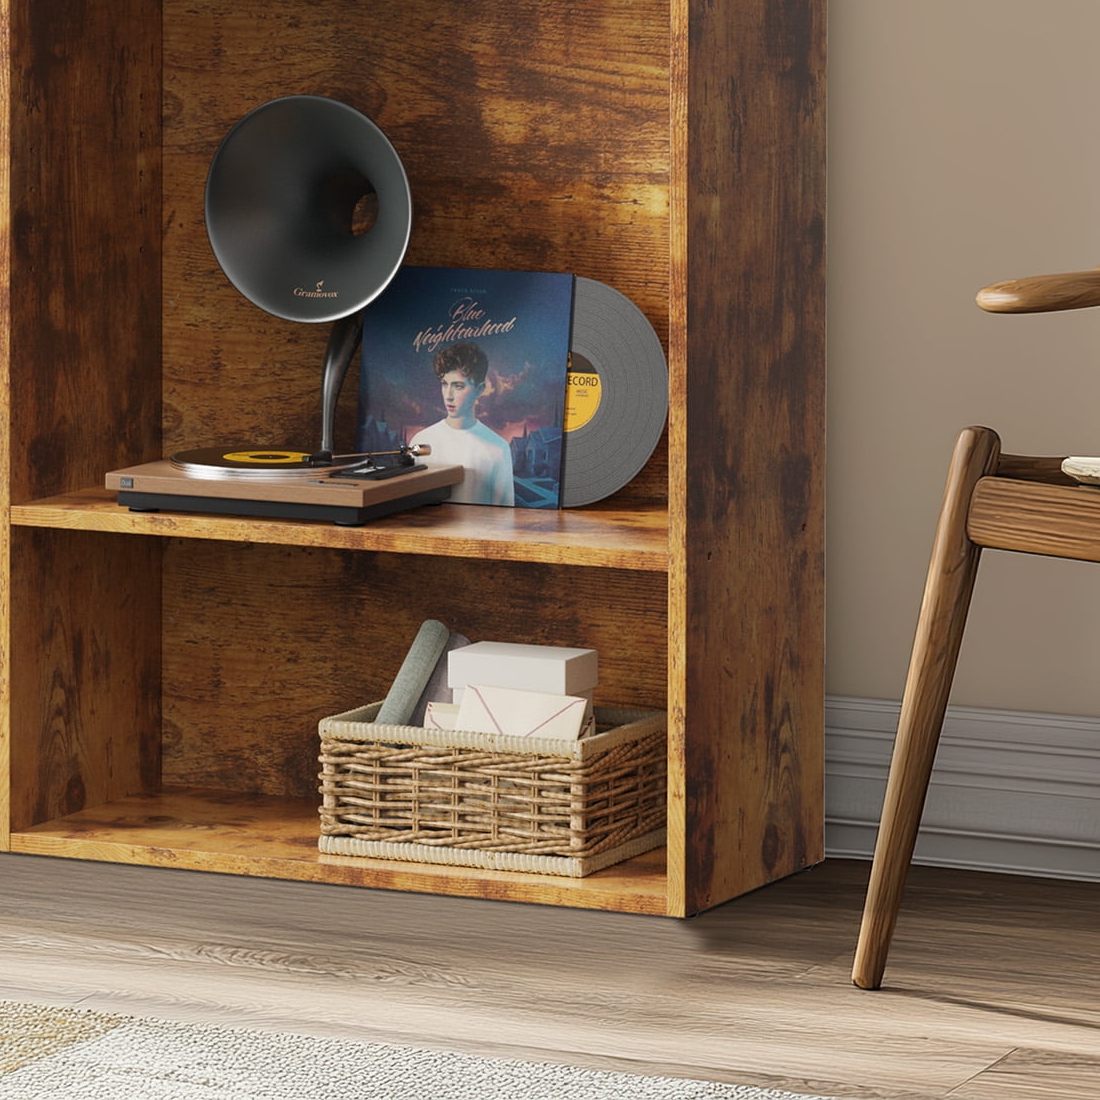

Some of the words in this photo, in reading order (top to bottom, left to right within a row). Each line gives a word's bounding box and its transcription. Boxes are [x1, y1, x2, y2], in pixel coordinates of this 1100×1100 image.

[293, 286, 339, 299] Gramovox
[449, 296, 487, 323] Blue
[412, 316, 517, 353] Neighbourhood
[568, 375, 599, 387] ECORD
